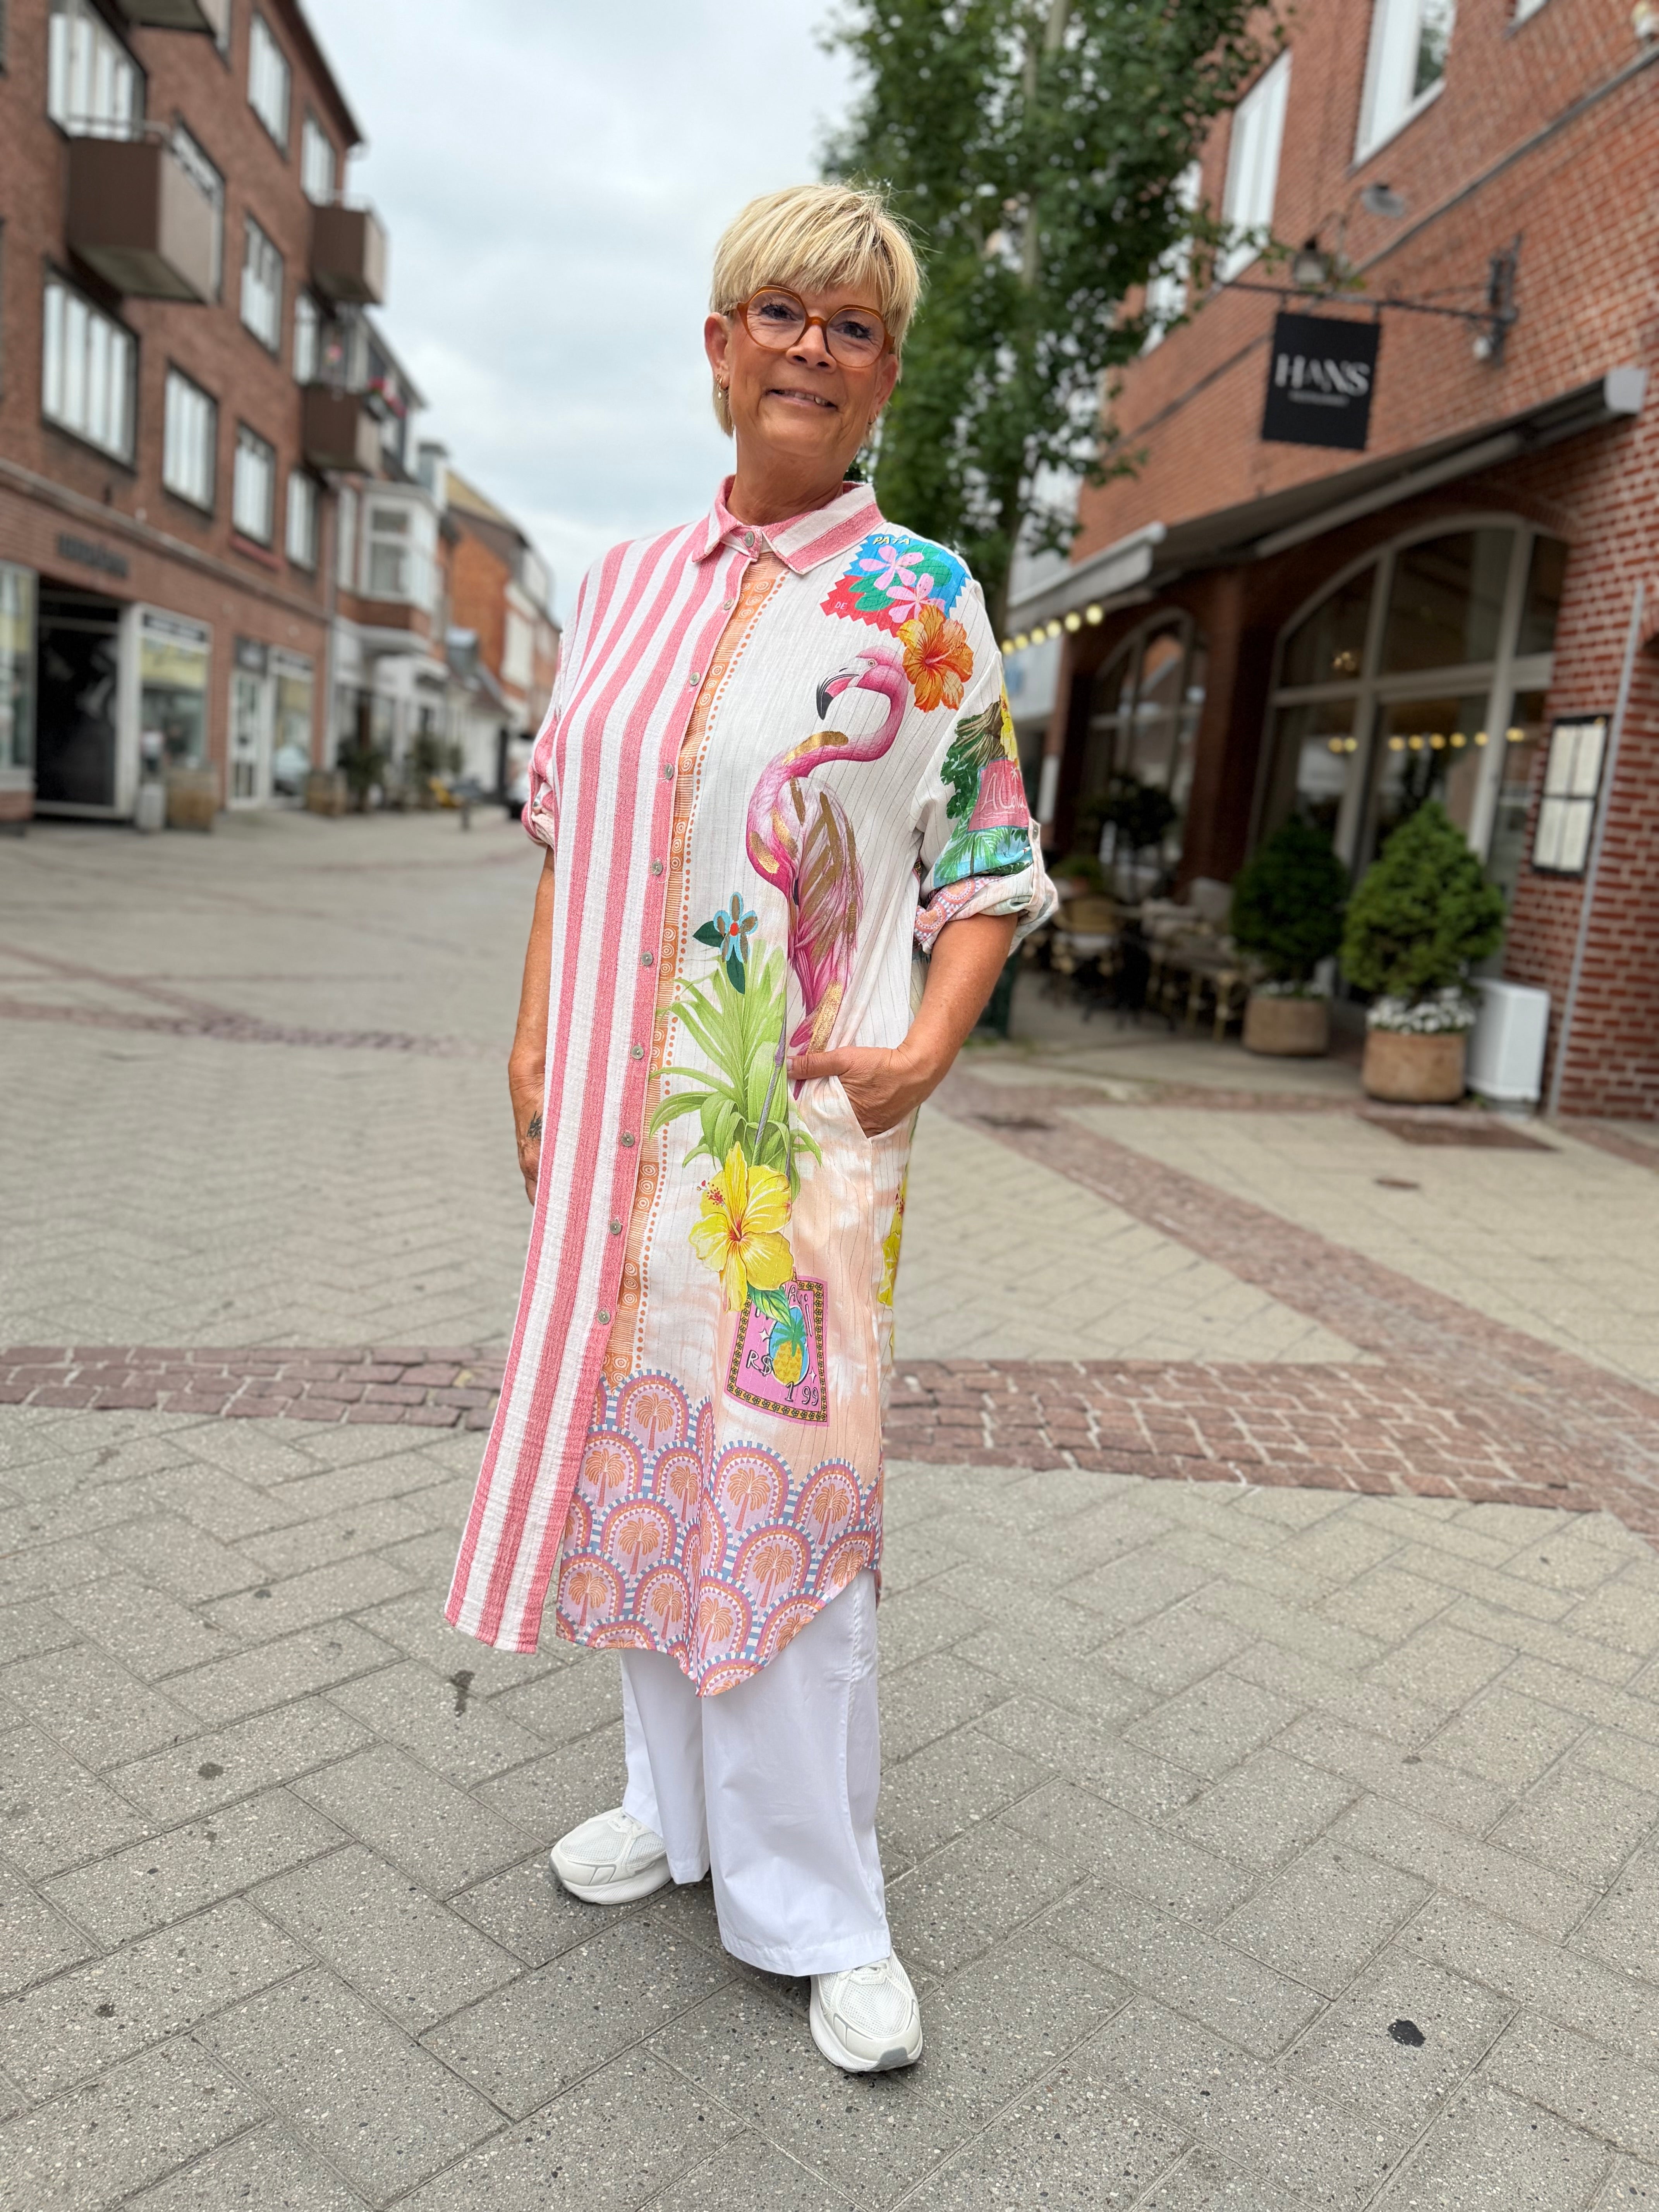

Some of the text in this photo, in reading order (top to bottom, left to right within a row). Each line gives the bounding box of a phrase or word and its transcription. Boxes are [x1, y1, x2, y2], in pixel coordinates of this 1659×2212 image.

[1275, 353, 1371, 397] HANS
[835, 601, 848, 610] DE
[746, 1349, 774, 1376] R$
[802, 1386, 819, 1406] 99
